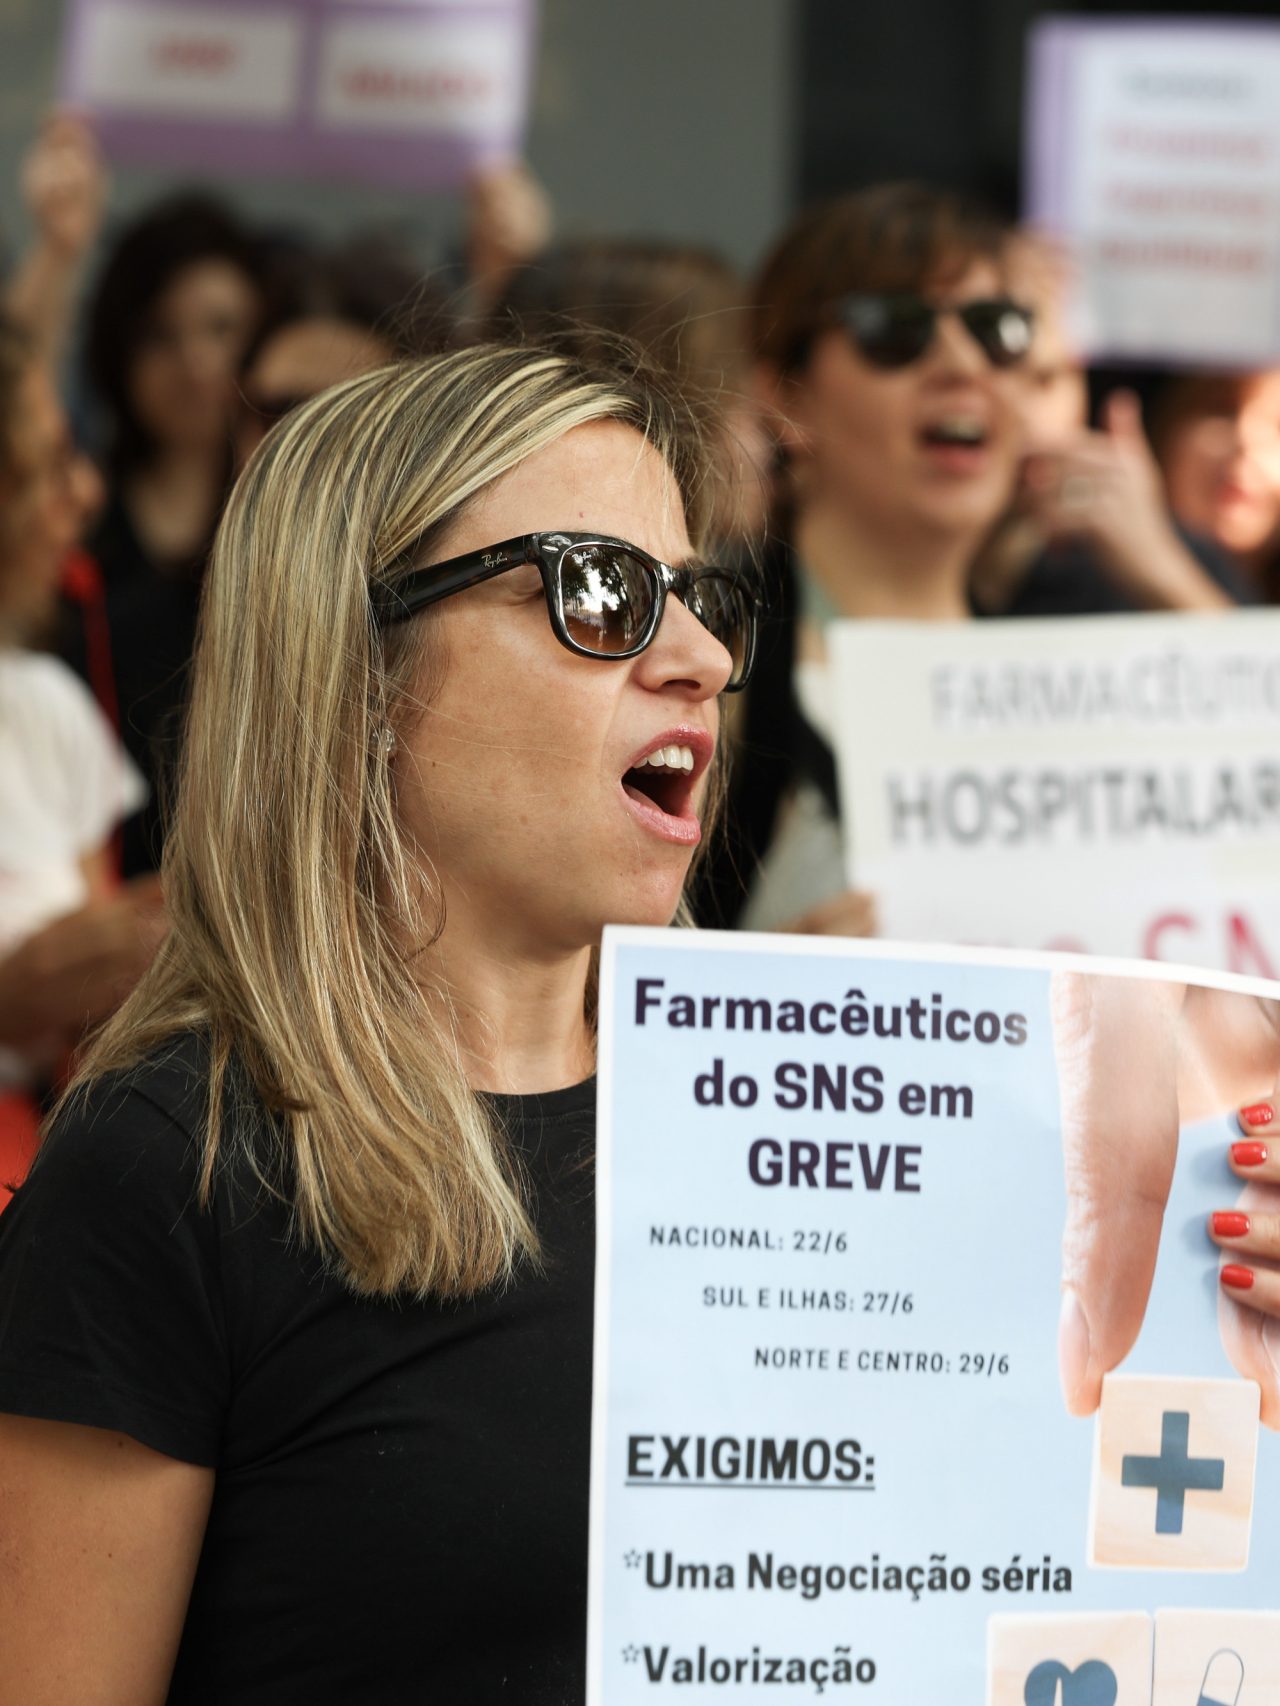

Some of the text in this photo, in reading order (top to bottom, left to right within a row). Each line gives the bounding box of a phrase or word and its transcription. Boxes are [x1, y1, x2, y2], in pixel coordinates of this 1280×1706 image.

[633, 978, 1028, 1046] Farmacêuticos
[693, 1058, 974, 1119] do SNS em
[747, 1138, 922, 1194] GREVE
[649, 1225, 848, 1254] NACIONAL: 22/6
[702, 1286, 914, 1315] SUL E ILHAS: 27/6
[754, 1347, 1010, 1377] NORTE E CENTRO: 29/6
[625, 1434, 876, 1484] EXIGIMOS:
[747, 1552, 972, 1601] Negociação
[981, 1555, 1073, 1593] séria
[642, 1645, 877, 1694] Valorização
